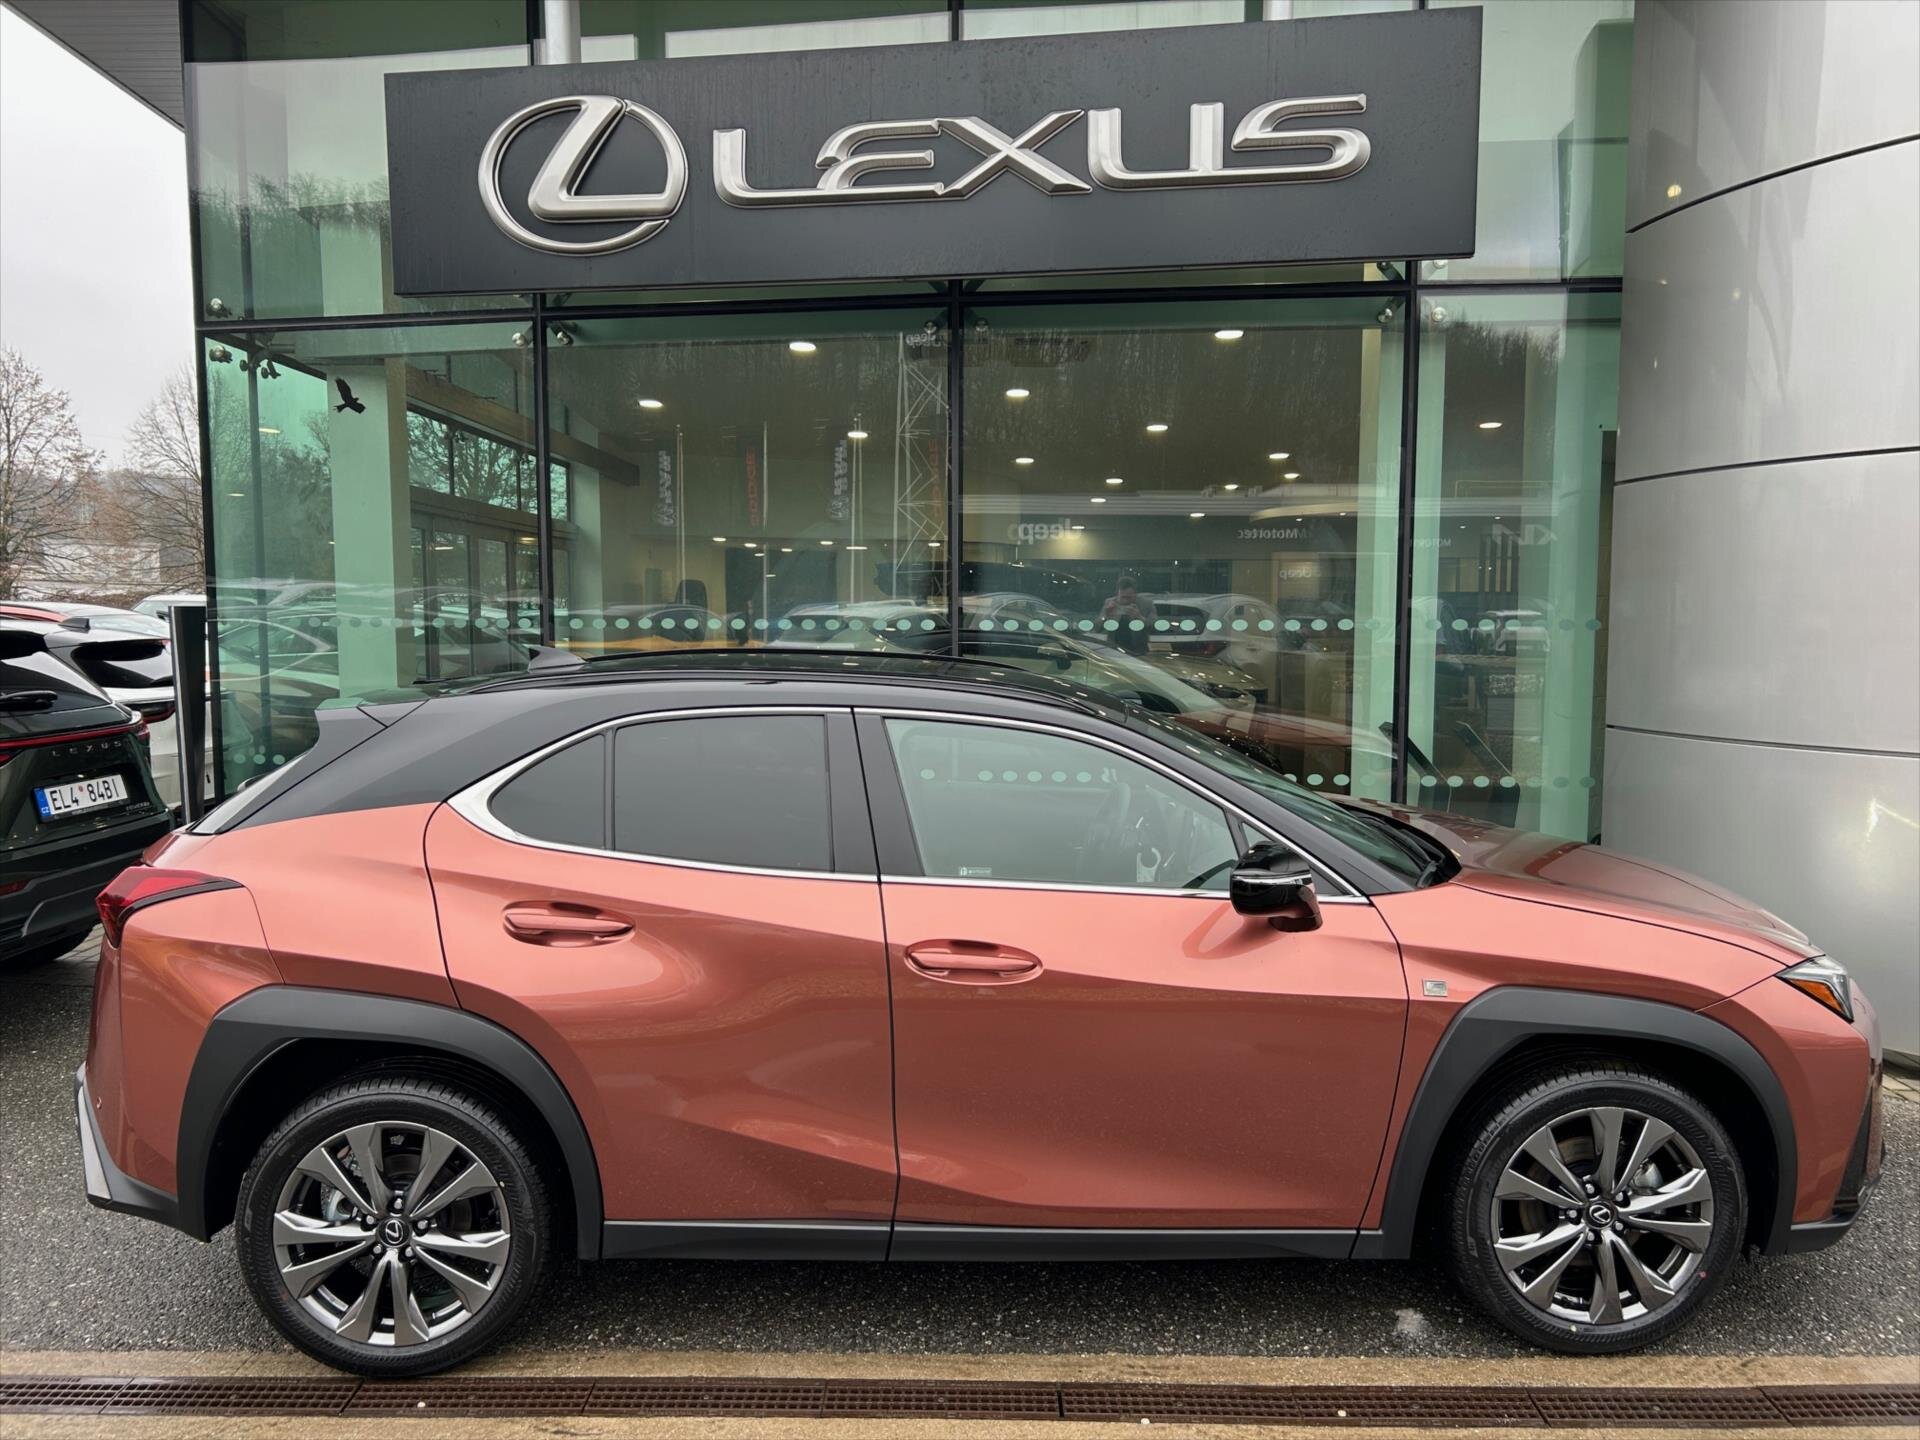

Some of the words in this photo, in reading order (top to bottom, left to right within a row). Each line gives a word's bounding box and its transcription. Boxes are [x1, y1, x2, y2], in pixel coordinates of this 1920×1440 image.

[713, 93, 1370, 207] LEXUS
[52, 741, 122, 757] LEXUS
[49, 786, 79, 811] EL4
